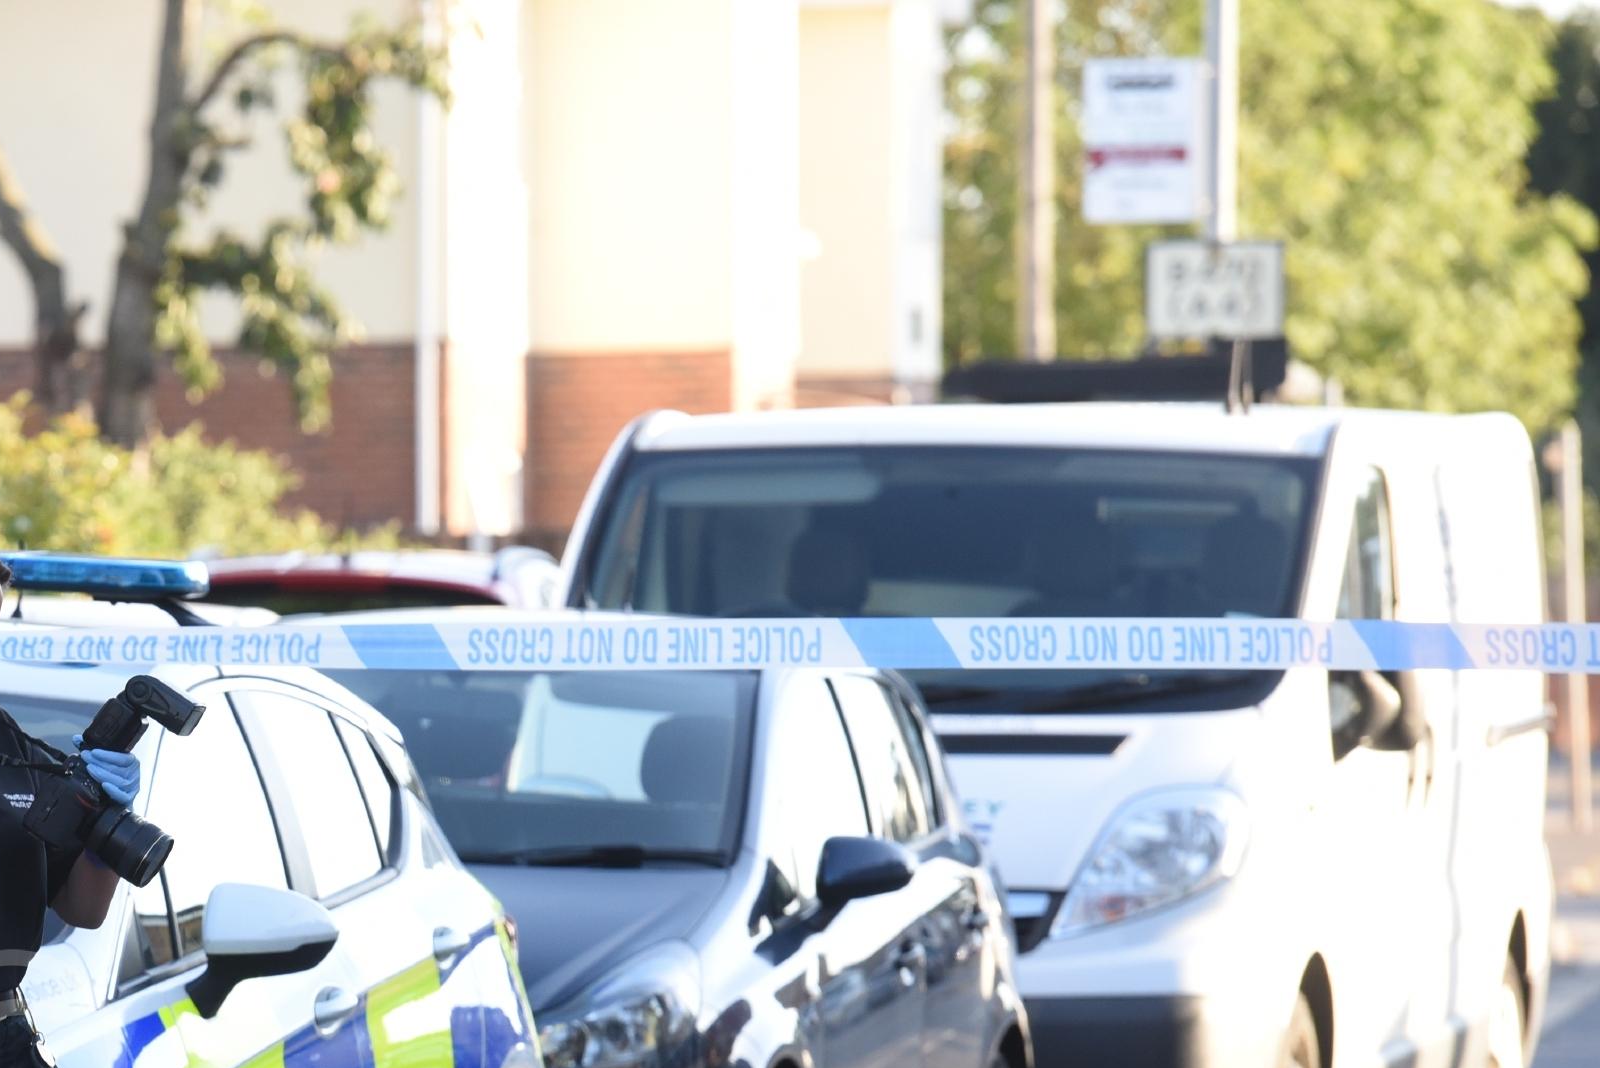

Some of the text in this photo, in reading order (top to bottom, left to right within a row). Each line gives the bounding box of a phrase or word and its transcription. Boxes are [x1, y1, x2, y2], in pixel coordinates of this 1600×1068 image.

[62, 635, 114, 661] NOT
[122, 635, 158, 662] DO
[167, 633, 222, 664] LINE
[231, 632, 321, 665] POLICE
[467, 625, 822, 665] POLICE LINE DO NOT CROSS
[969, 624, 1333, 665] POLICE LINE DO NOT CROSS
[1485, 628, 1576, 667] CROSS
